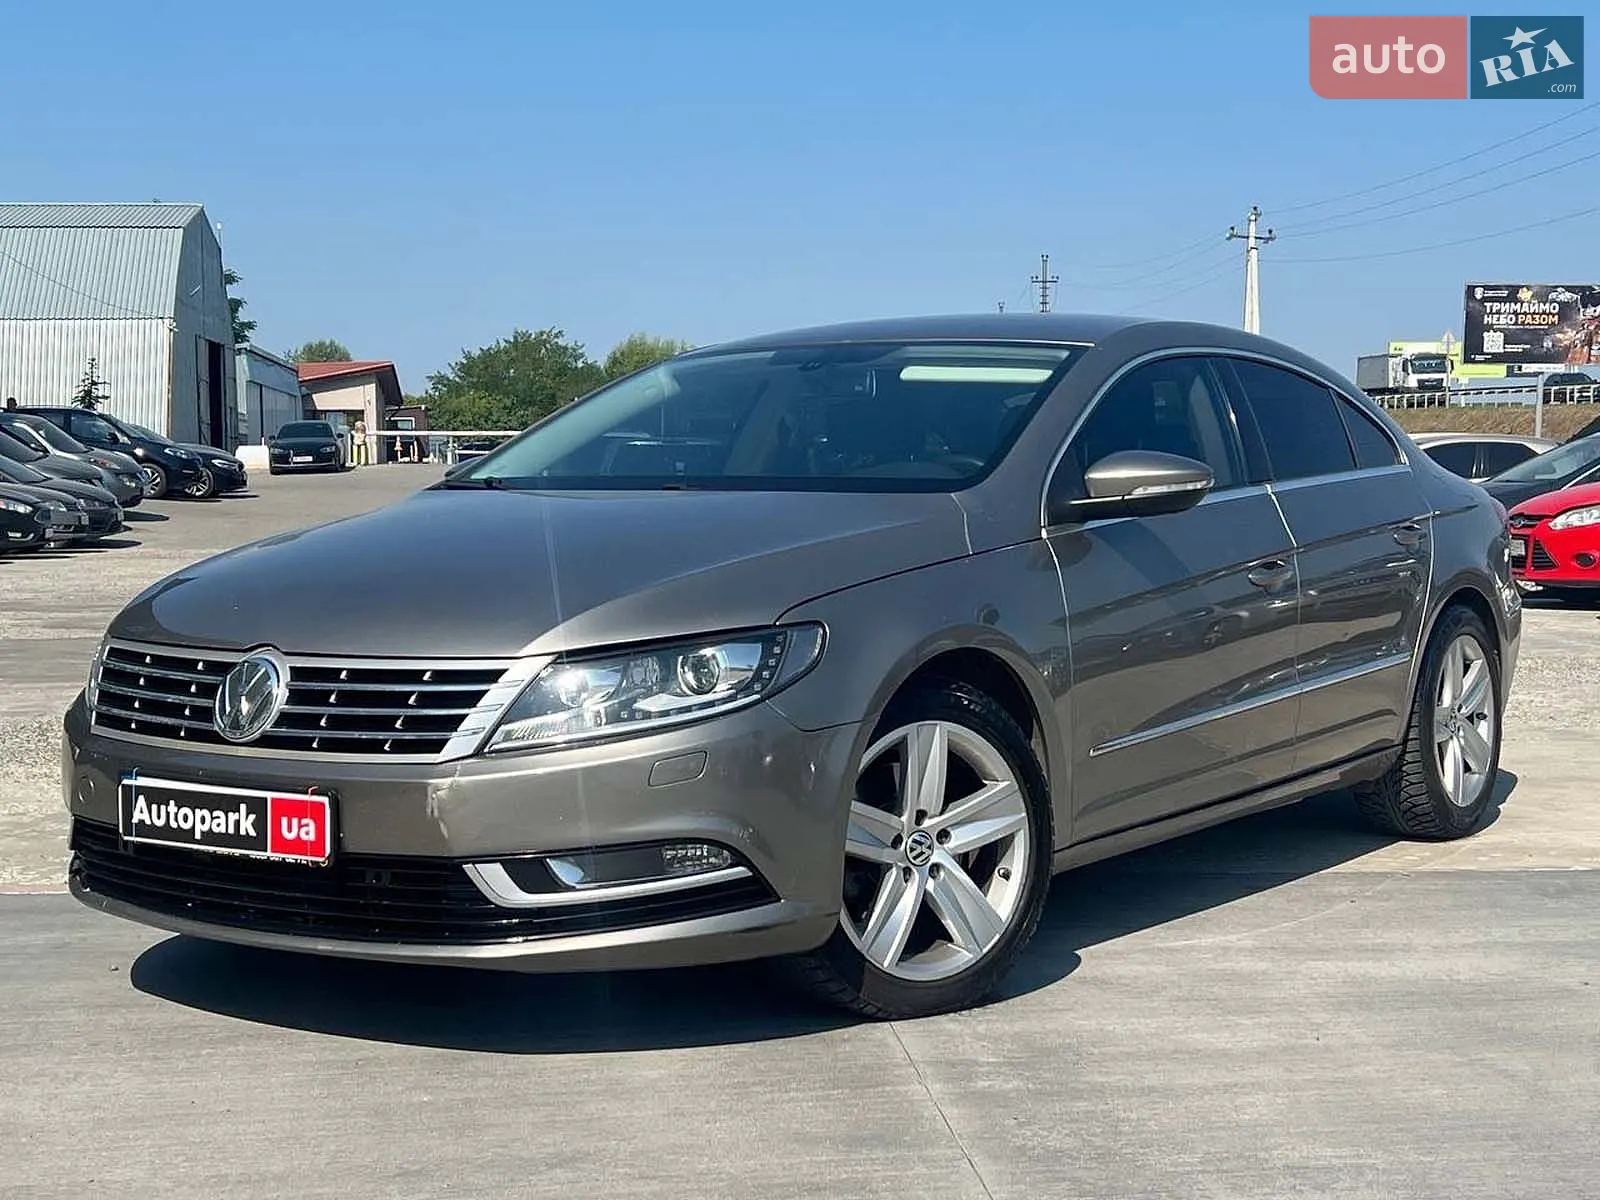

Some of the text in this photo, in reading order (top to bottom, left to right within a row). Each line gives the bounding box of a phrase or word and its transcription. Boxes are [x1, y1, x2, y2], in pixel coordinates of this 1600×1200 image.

[1484, 300, 1559, 313] ТРИМАЙМО
[1483, 314, 1559, 325] НЕБО РАЗОМ
[131, 794, 316, 842] Autopark ua
